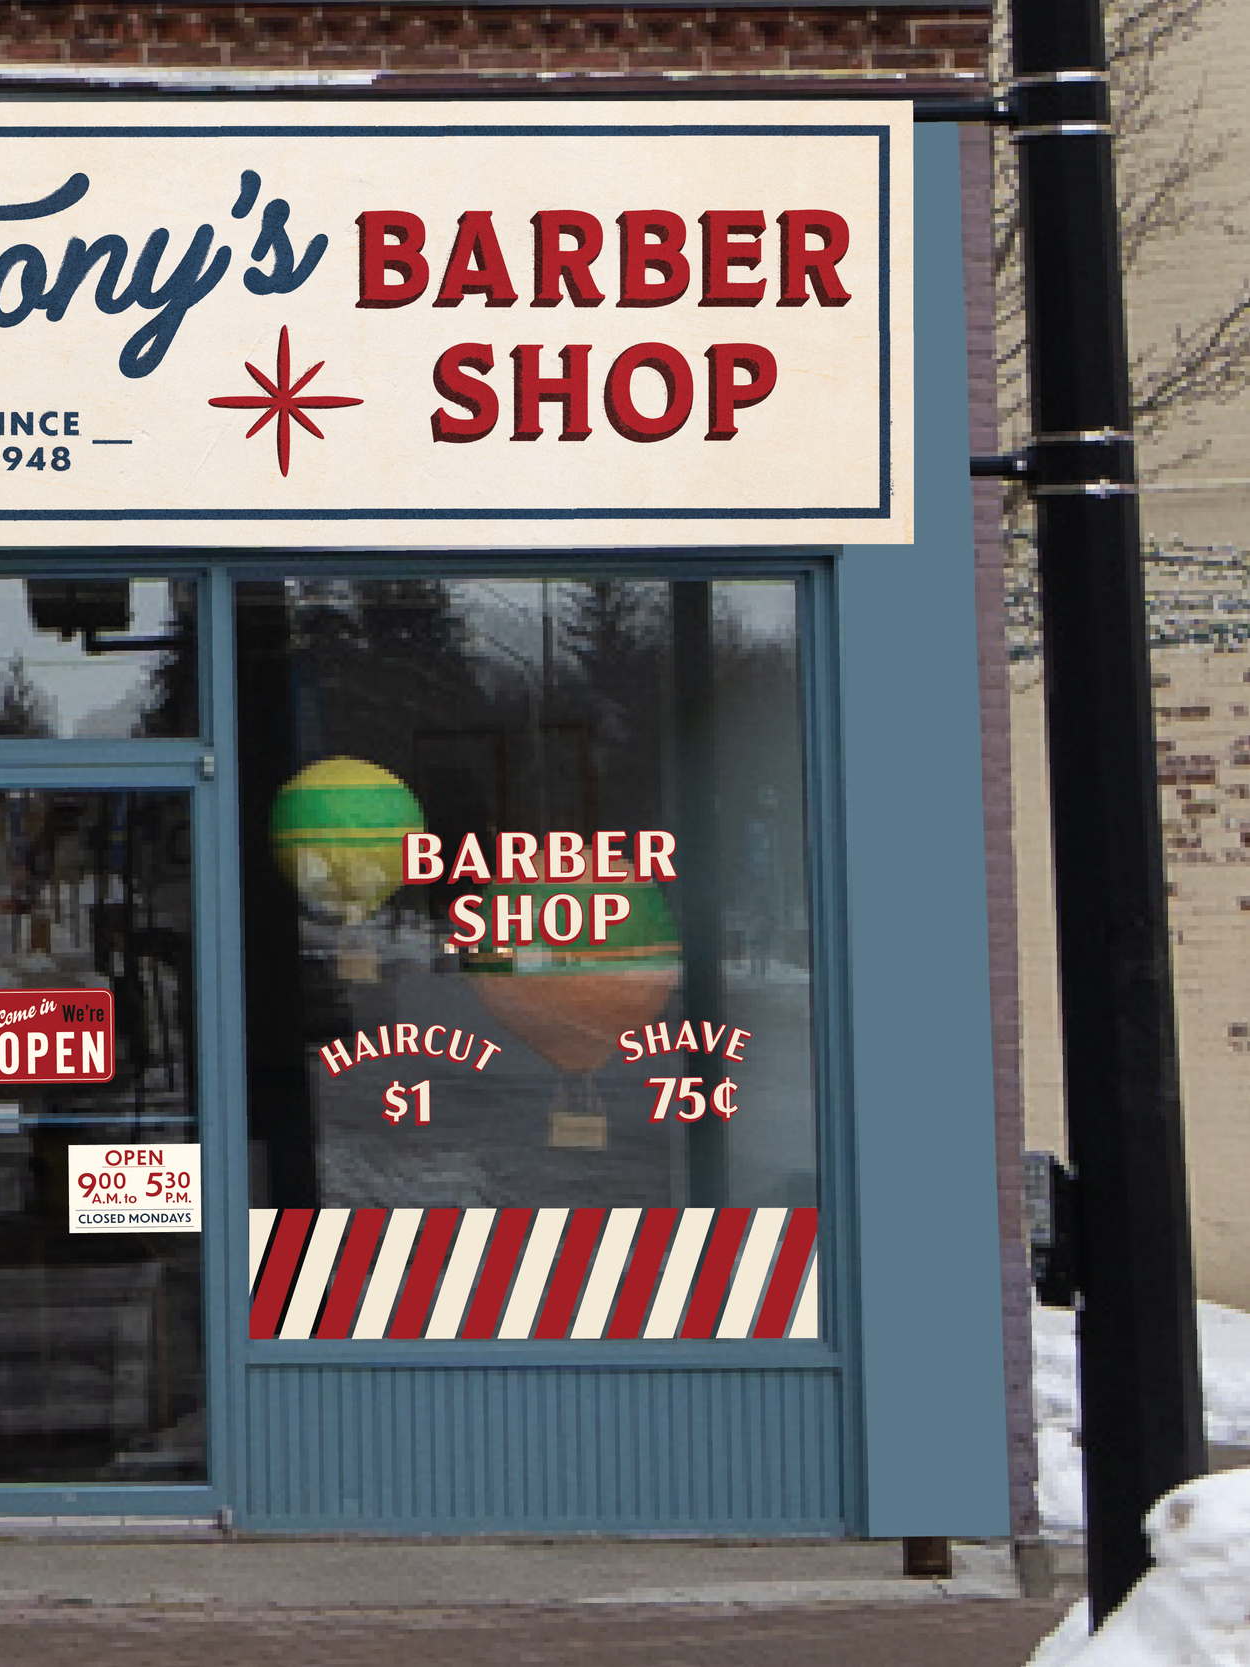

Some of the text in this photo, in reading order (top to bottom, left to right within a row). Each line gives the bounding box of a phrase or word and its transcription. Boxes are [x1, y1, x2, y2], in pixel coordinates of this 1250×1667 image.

[354, 208, 852, 309] BARBER
[430, 341, 778, 443] SHOP
[402, 830, 679, 885] BARBER
[447, 893, 631, 947] SHOP
[39, 998, 58, 1016] in
[62, 1004, 105, 1023] We're
[318, 1022, 502, 1079] HAIRCUT
[617, 1019, 751, 1064] SHAVE
[381, 1079, 431, 1126] $1
[643, 1076, 739, 1124] 75¢
[105, 1150, 163, 1166] OPEN
[78, 1213, 191, 1224] CLOSED MONDAYS
[92, 1193, 122, 1204] A.M.
[124, 1193, 137, 1204] to
[165, 1192, 192, 1203] P.M.
